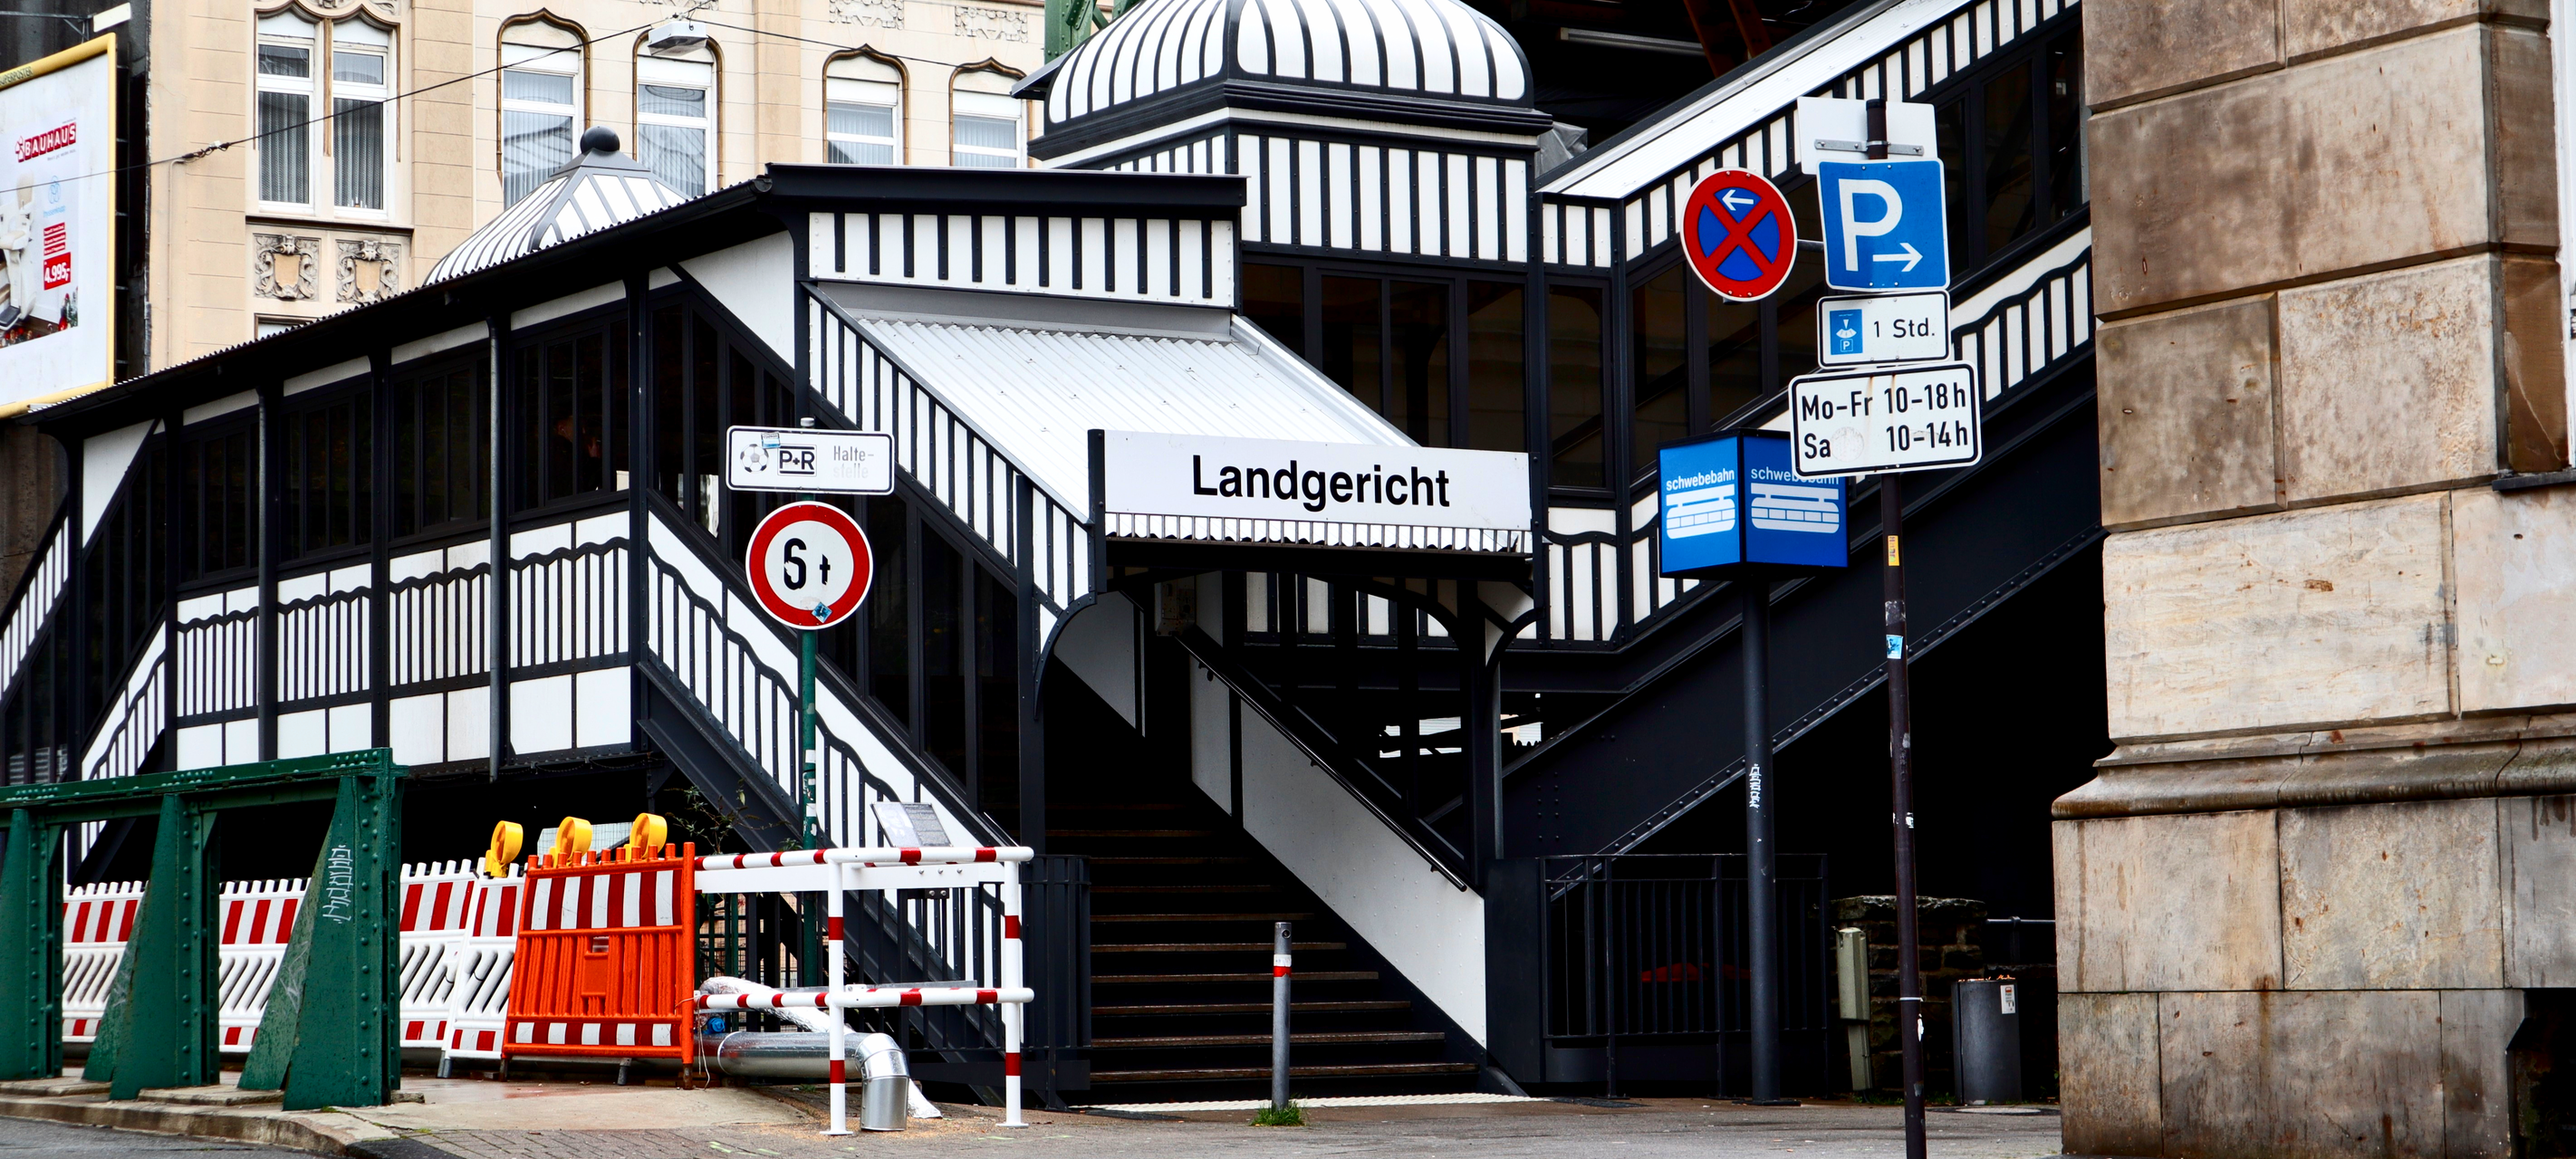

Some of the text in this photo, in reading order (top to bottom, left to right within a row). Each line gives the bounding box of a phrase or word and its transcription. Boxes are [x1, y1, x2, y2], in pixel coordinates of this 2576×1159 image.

[24, 124, 76, 158] BAUHAUS
[1838, 178, 1903, 273] P
[1873, 317, 1936, 339] 1 Std.
[1802, 390, 1873, 421] Mo-Fr
[833, 445, 875, 462] Halte-
[1803, 433, 1831, 459] Sa
[1192, 454, 1451, 512] Landgericht
[1666, 467, 1735, 492] schwebebahn
[783, 537, 831, 591] 6 t
